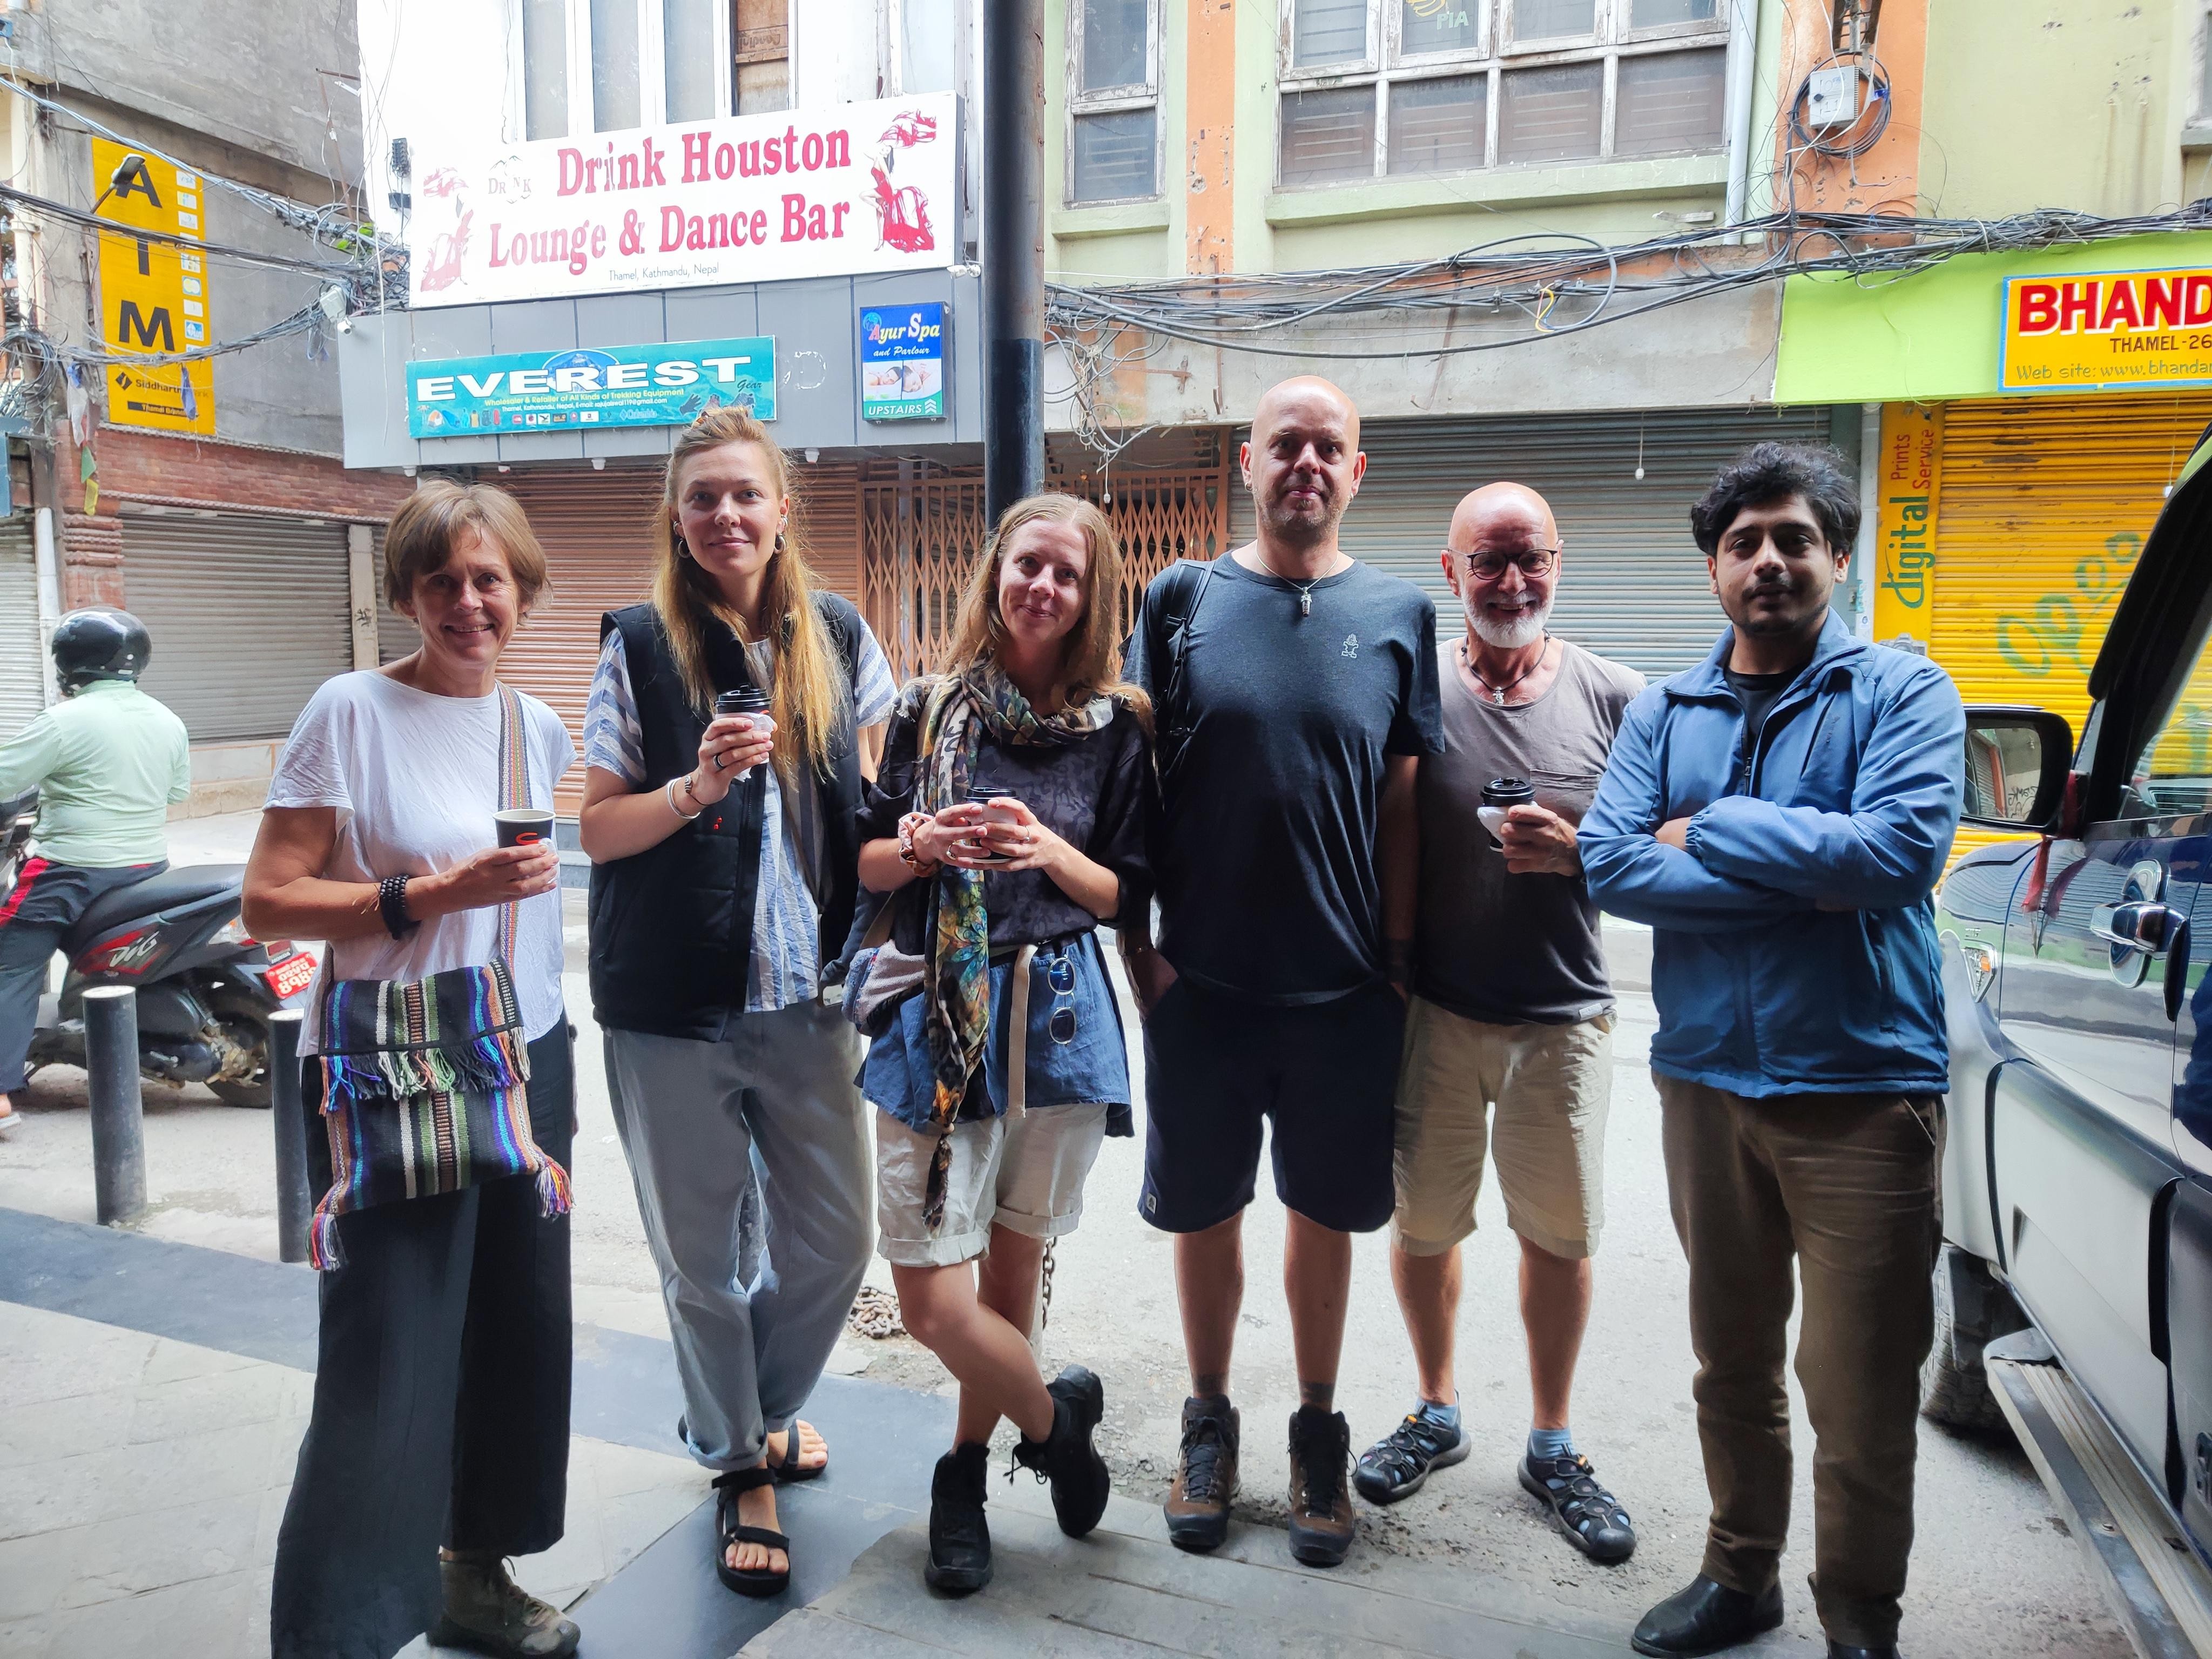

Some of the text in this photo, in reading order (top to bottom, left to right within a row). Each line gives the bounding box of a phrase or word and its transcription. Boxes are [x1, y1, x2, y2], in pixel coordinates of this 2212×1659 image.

[1437, 11, 1469, 30] PIA
[557, 125, 851, 196] Drink Houston
[488, 177, 531, 194] DRNK
[489, 193, 850, 276] Lounge & Dance Bar
[609, 261, 719, 281] Thamel, Kathmandu, Nepal
[2019, 274, 2212, 336] BHAND
[868, 313, 940, 344] Ayur Spa
[873, 346, 930, 356] and Parlour
[416, 356, 751, 402] EVEREST
[2017, 364, 2052, 380] Web
[2059, 363, 2096, 379] site:
[611, 390, 642, 400] Trekking
[643, 388, 684, 398] Equipment
[737, 379, 763, 392] Gear
[868, 404, 922, 415] UPSTAIRS
[1891, 434, 1910, 480] Prints
[1912, 429, 1934, 489] Service
[1881, 496, 1936, 609] digital
